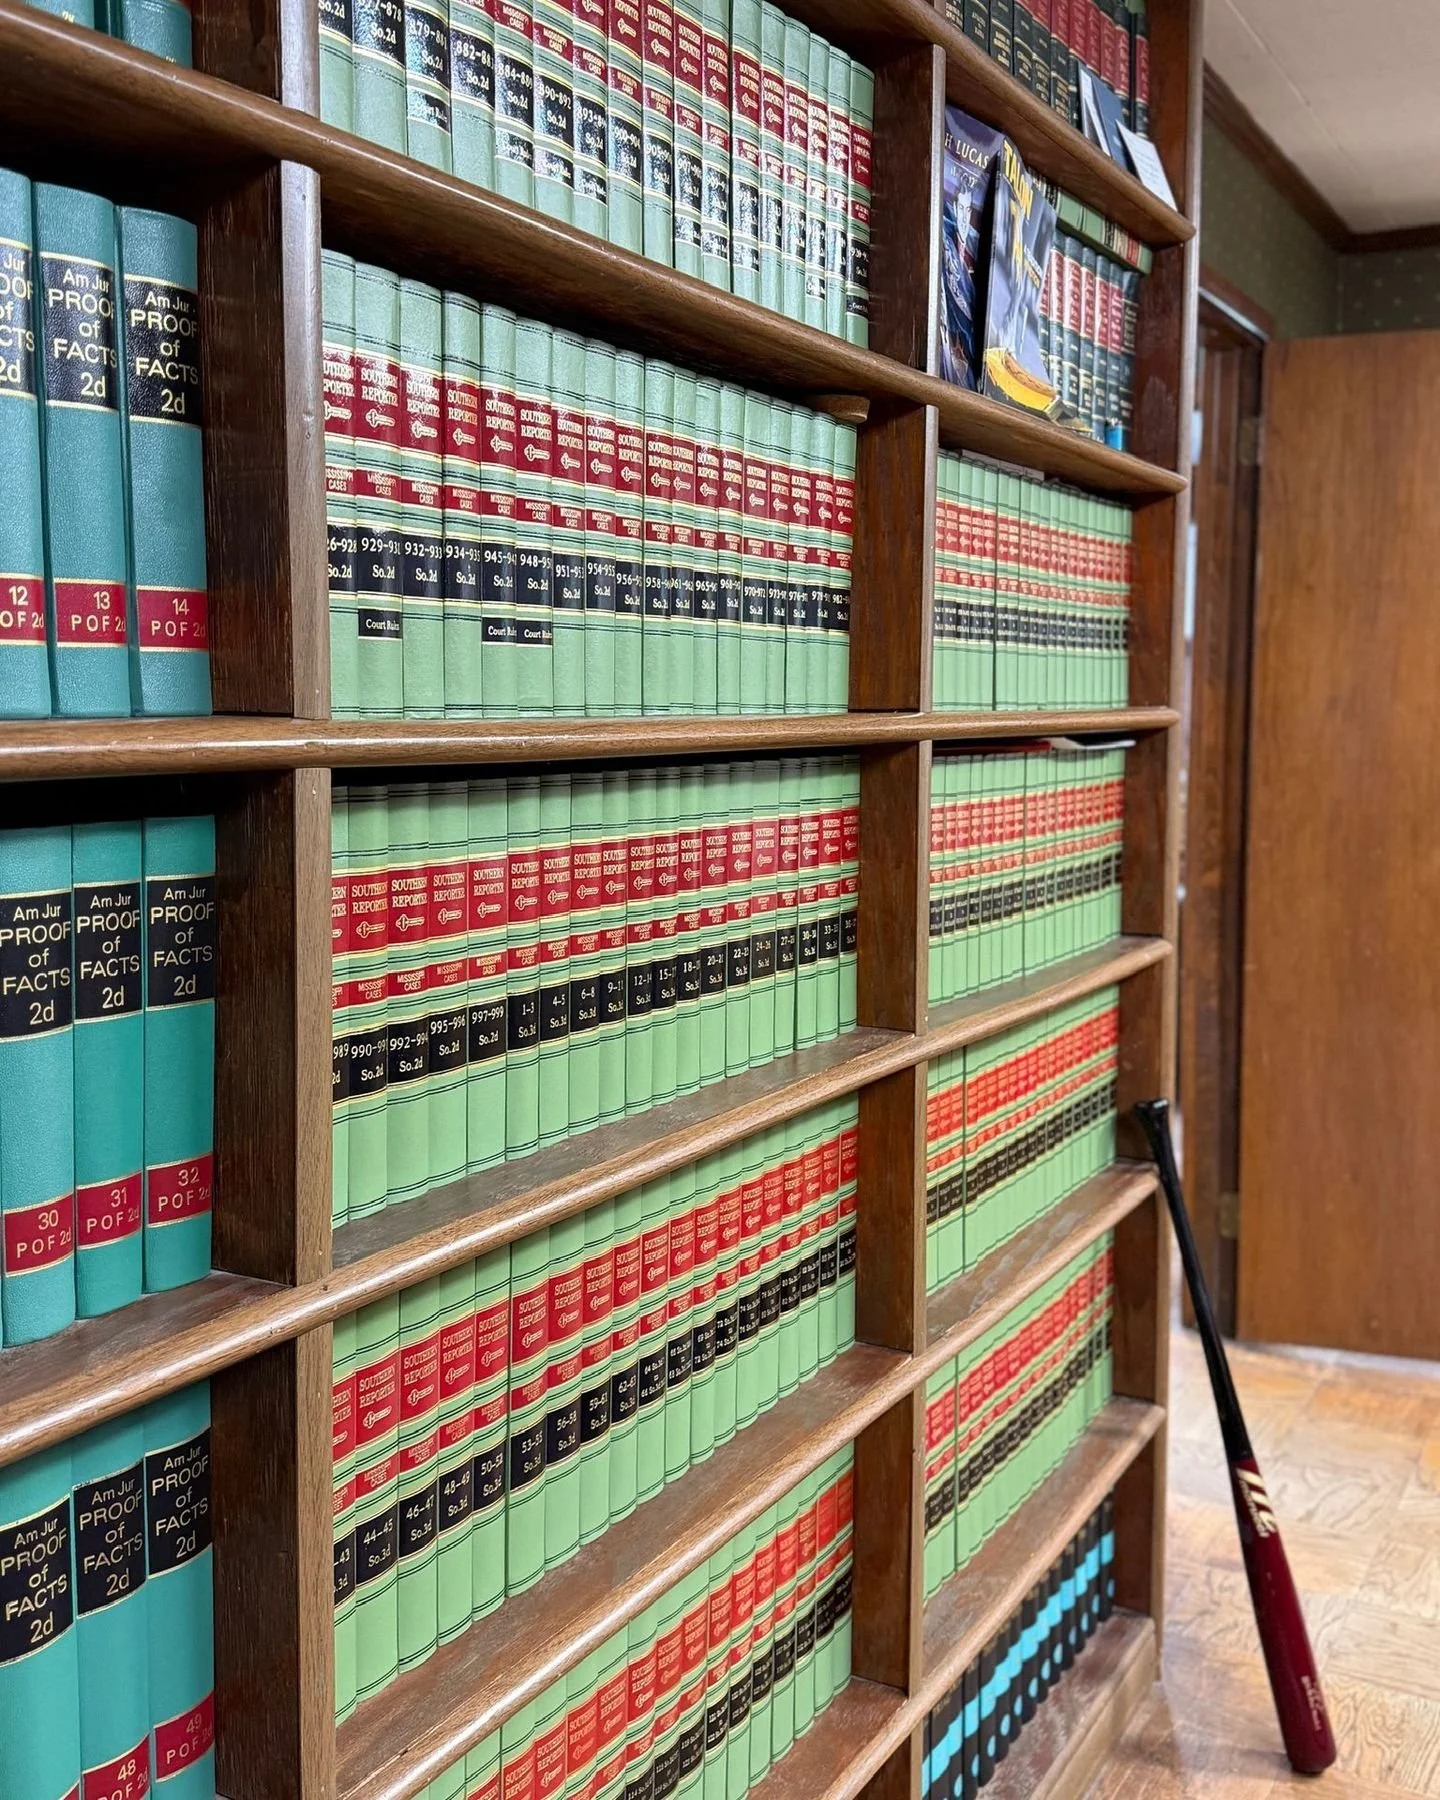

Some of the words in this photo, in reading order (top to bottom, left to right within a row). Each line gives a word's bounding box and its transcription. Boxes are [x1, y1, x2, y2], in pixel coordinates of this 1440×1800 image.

[956, 140, 989, 169] LUCAS
[4, 254, 25, 271] Jur
[63, 268, 89, 289] Am
[92, 277, 110, 293] Jur
[145, 291, 171, 310] Am
[173, 297, 191, 313] Jur
[79, 320, 101, 338] of
[130, 309, 198, 338] PROOF
[53, 338, 118, 369] FACTS
[160, 339, 181, 357] of
[135, 357, 199, 385] FACTS
[80, 372, 106, 398] 2d
[161, 389, 186, 414] 2d
[372, 564, 396, 580] So.2d
[415, 568, 438, 583] So.2d
[456, 571, 476, 586] So.2d
[527, 577, 549, 591] So.2d
[9, 586, 29, 606] 12
[94, 591, 111, 610] 13
[172, 598, 190, 616] 14
[366, 618, 387, 630] Court
[90, 895, 112, 909] Am
[115, 893, 132, 908] Jur
[163, 888, 187, 901] Am
[188, 886, 207, 899] Jur
[13, 906, 39, 922] Am
[42, 903, 62, 919] Jur
[77, 910, 141, 934] PROOF
[150, 902, 215, 925] PROOF
[0, 921, 71, 948] PROOF
[102, 936, 121, 954] of
[175, 927, 195, 945] of
[28, 948, 50, 968] of
[153, 945, 213, 968] FACTS
[80, 955, 140, 980] FACTS
[443, 973, 458, 983] CASES
[3, 967, 71, 995] FACTS
[173, 974, 197, 997] 2d
[404, 980, 421, 992] CASES
[102, 985, 125, 1009] 2d
[365, 988, 382, 1000] CASES
[552, 993, 566, 1006] 4-5
[581, 986, 595, 1000] 6-8
[29, 1000, 55, 1026] 2d
[472, 1005, 504, 1024] 997-999
[522, 1002, 535, 1016] 1-3
[578, 1006, 597, 1020] So.3d
[430, 1014, 466, 1035] 995-996
[518, 1023, 537, 1038] So.3d
[550, 1014, 567, 1029] So.3d
[439, 1040, 460, 1056] So.2d
[478, 1030, 499, 1046] So.2d
[361, 1063, 384, 1081] So.2d
[399, 1056, 423, 1072] So.2d
[178, 1166, 200, 1186] 32
[110, 1187, 128, 1208] 31
[38, 1209, 60, 1231] 30
[59, 1226, 72, 1246] 2d
[359, 1363, 395, 1392] SOUTHERN
[359, 1381, 396, 1409] REPORTER
[556, 1410, 577, 1431] 56-58
[590, 1414, 607, 1429] So.3d
[521, 1430, 543, 1453] 53-55
[557, 1433, 576, 1451] So.3d
[163, 1454, 185, 1471] Am
[187, 1446, 201, 1461] Jur
[523, 1453, 541, 1473] So.3d
[152, 1455, 209, 1496] PROOF
[444, 1471, 470, 1495] 48-49
[483, 1475, 502, 1496] So.3d
[91, 1489, 115, 1505] Am
[117, 1478, 135, 1496] Jur
[175, 1486, 193, 1508] of
[79, 1489, 143, 1531] PROOF
[155, 1497, 209, 1537] FACTS
[406, 1494, 434, 1520] 46-47
[447, 1496, 468, 1517] So.3d
[14, 1532, 39, 1549] Am
[40, 1517, 58, 1536] Jur
[105, 1522, 126, 1544] of
[363, 1518, 393, 1545] 44-45
[410, 1520, 433, 1541] So.3d
[1, 1527, 68, 1576] PROOF
[83, 1532, 143, 1575] FACTS
[175, 1530, 196, 1559] 2d
[368, 1543, 391, 1567] So.3d
[28, 1564, 49, 1589] of
[106, 1568, 130, 1596] 2d
[5, 1573, 68, 1621] FACTS
[30, 1611, 55, 1644] 2d
[186, 1714, 202, 1733] 49
[117, 1758, 137, 1781] 48
